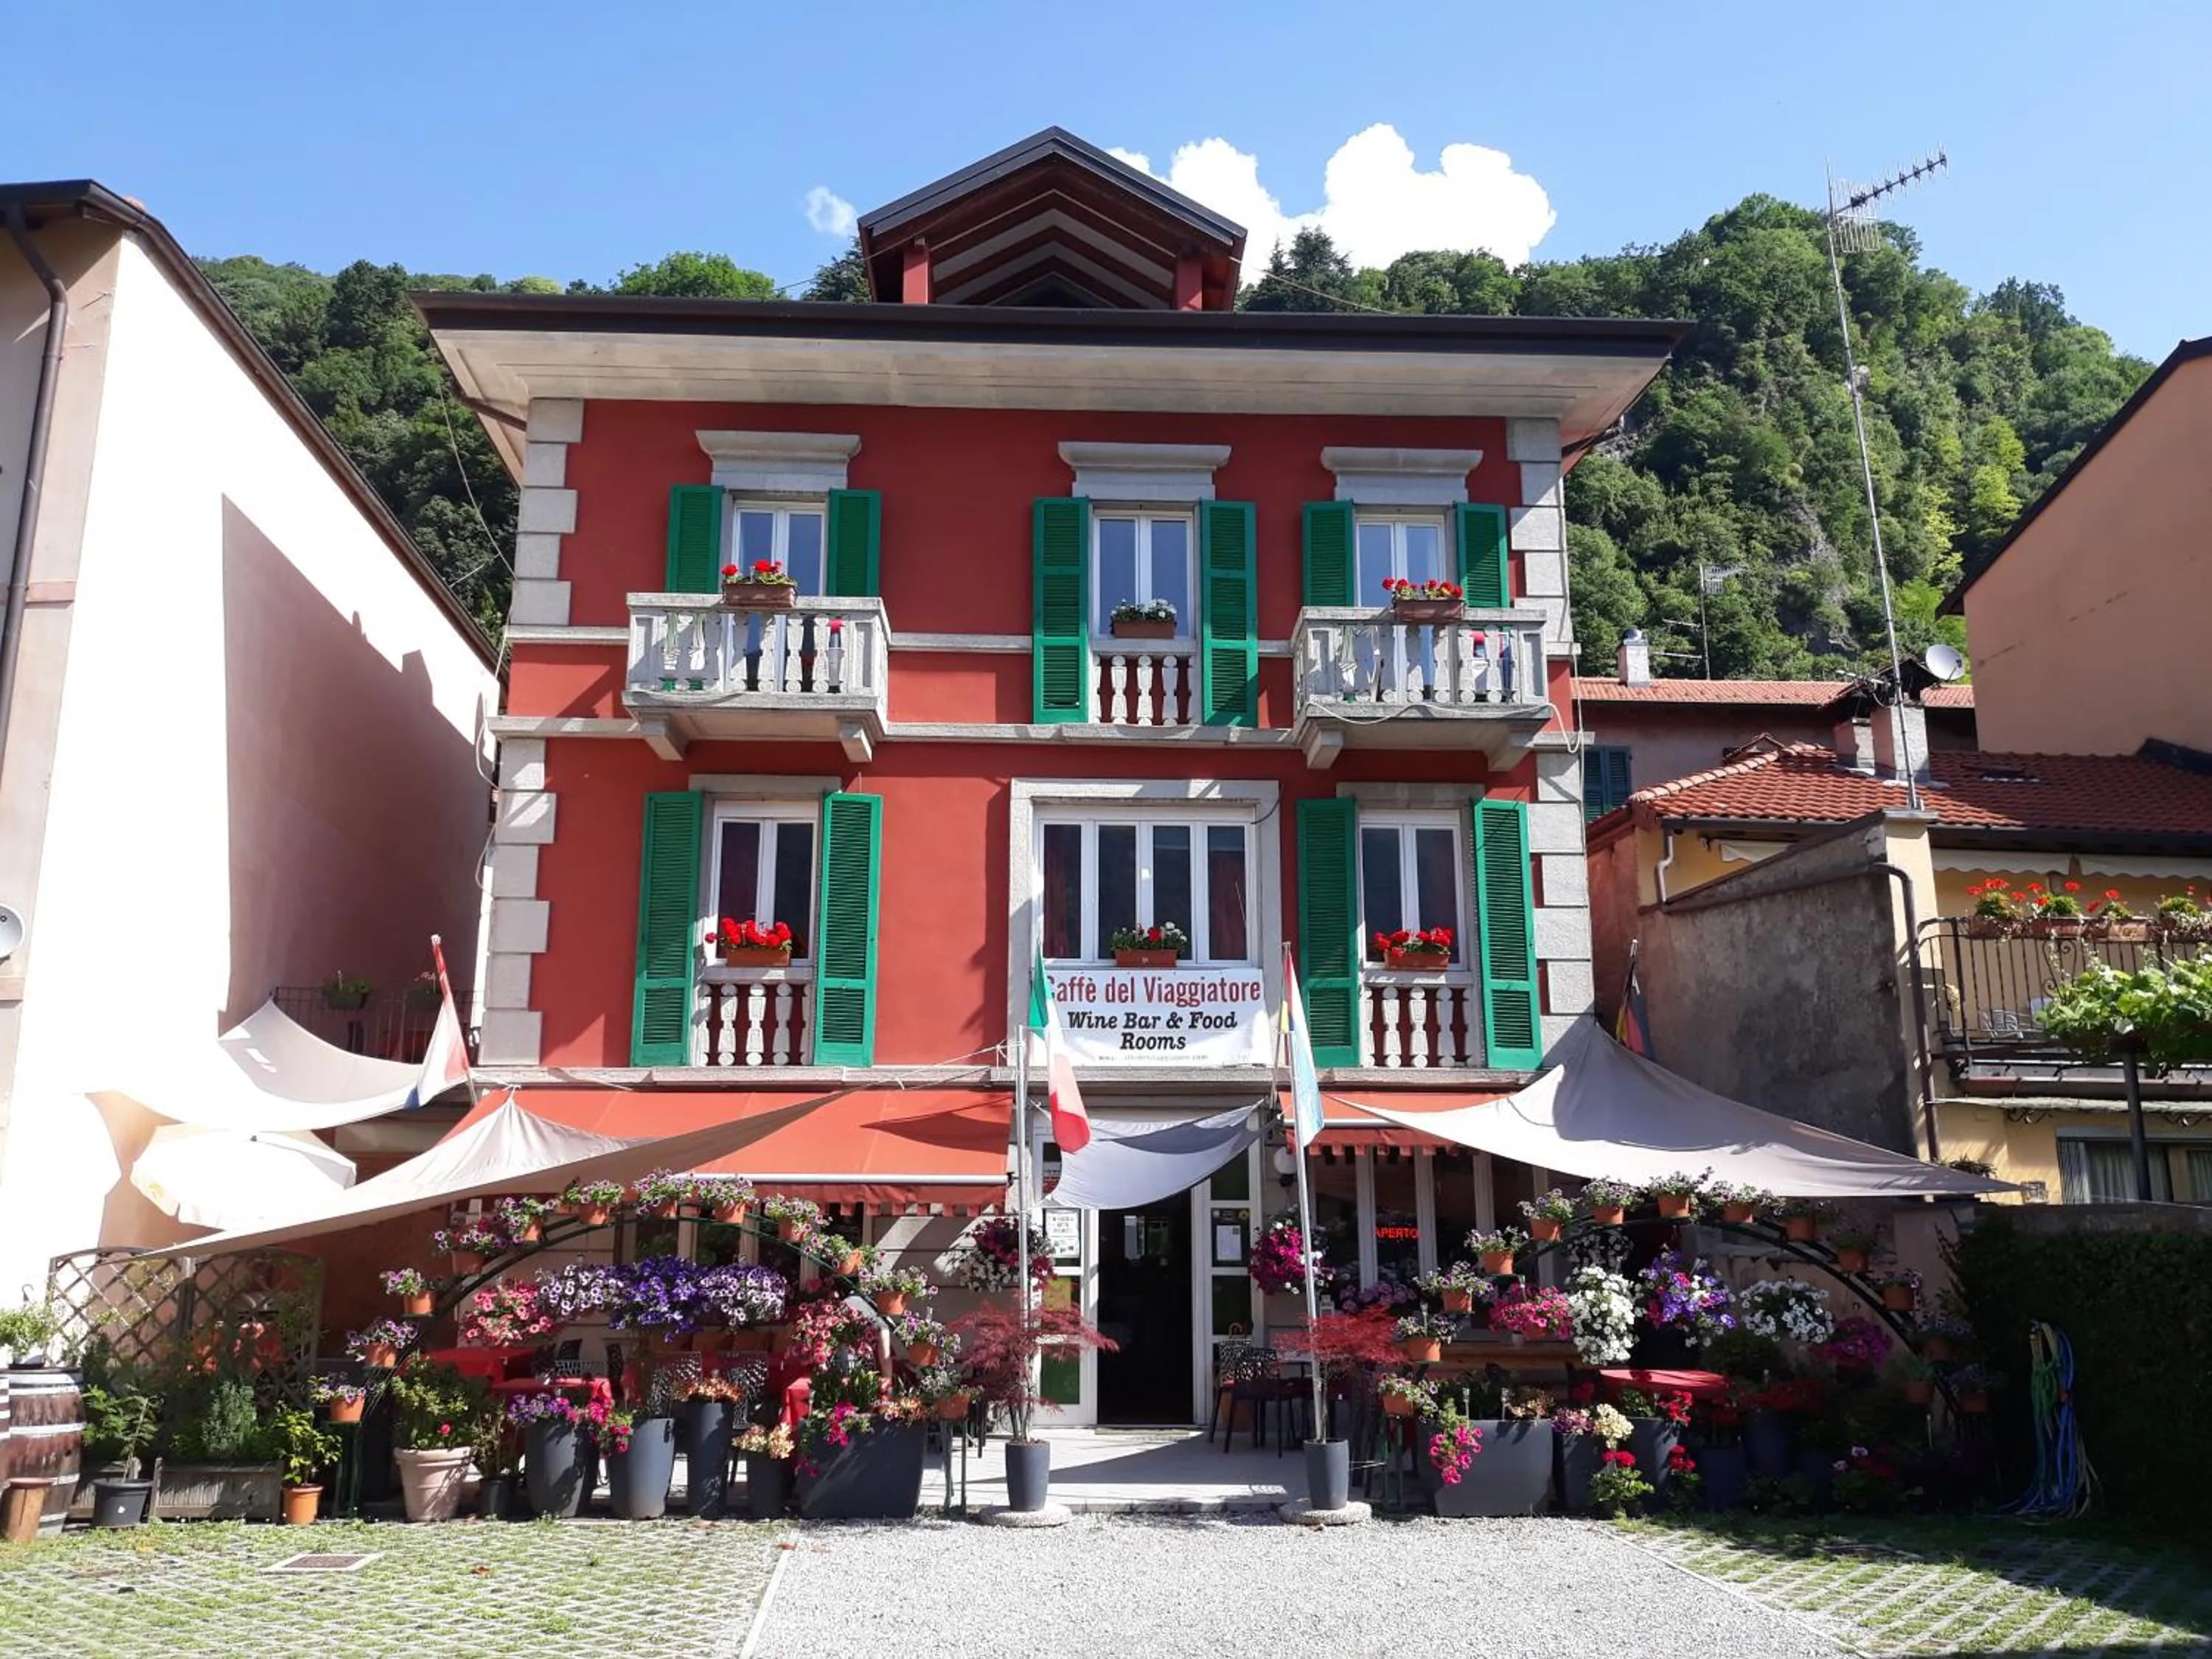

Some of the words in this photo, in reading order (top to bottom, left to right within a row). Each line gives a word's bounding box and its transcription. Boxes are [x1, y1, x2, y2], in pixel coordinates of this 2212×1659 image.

[1105, 976, 1135, 1004] del
[1143, 976, 1260, 1007] Viaggiatore
[1068, 1010, 1118, 1029] Wine
[1123, 1012, 1161, 1029] Bar
[1166, 1012, 1183, 1029] &
[1189, 1011, 1237, 1029] Food
[1119, 1032, 1186, 1051] Rooms
